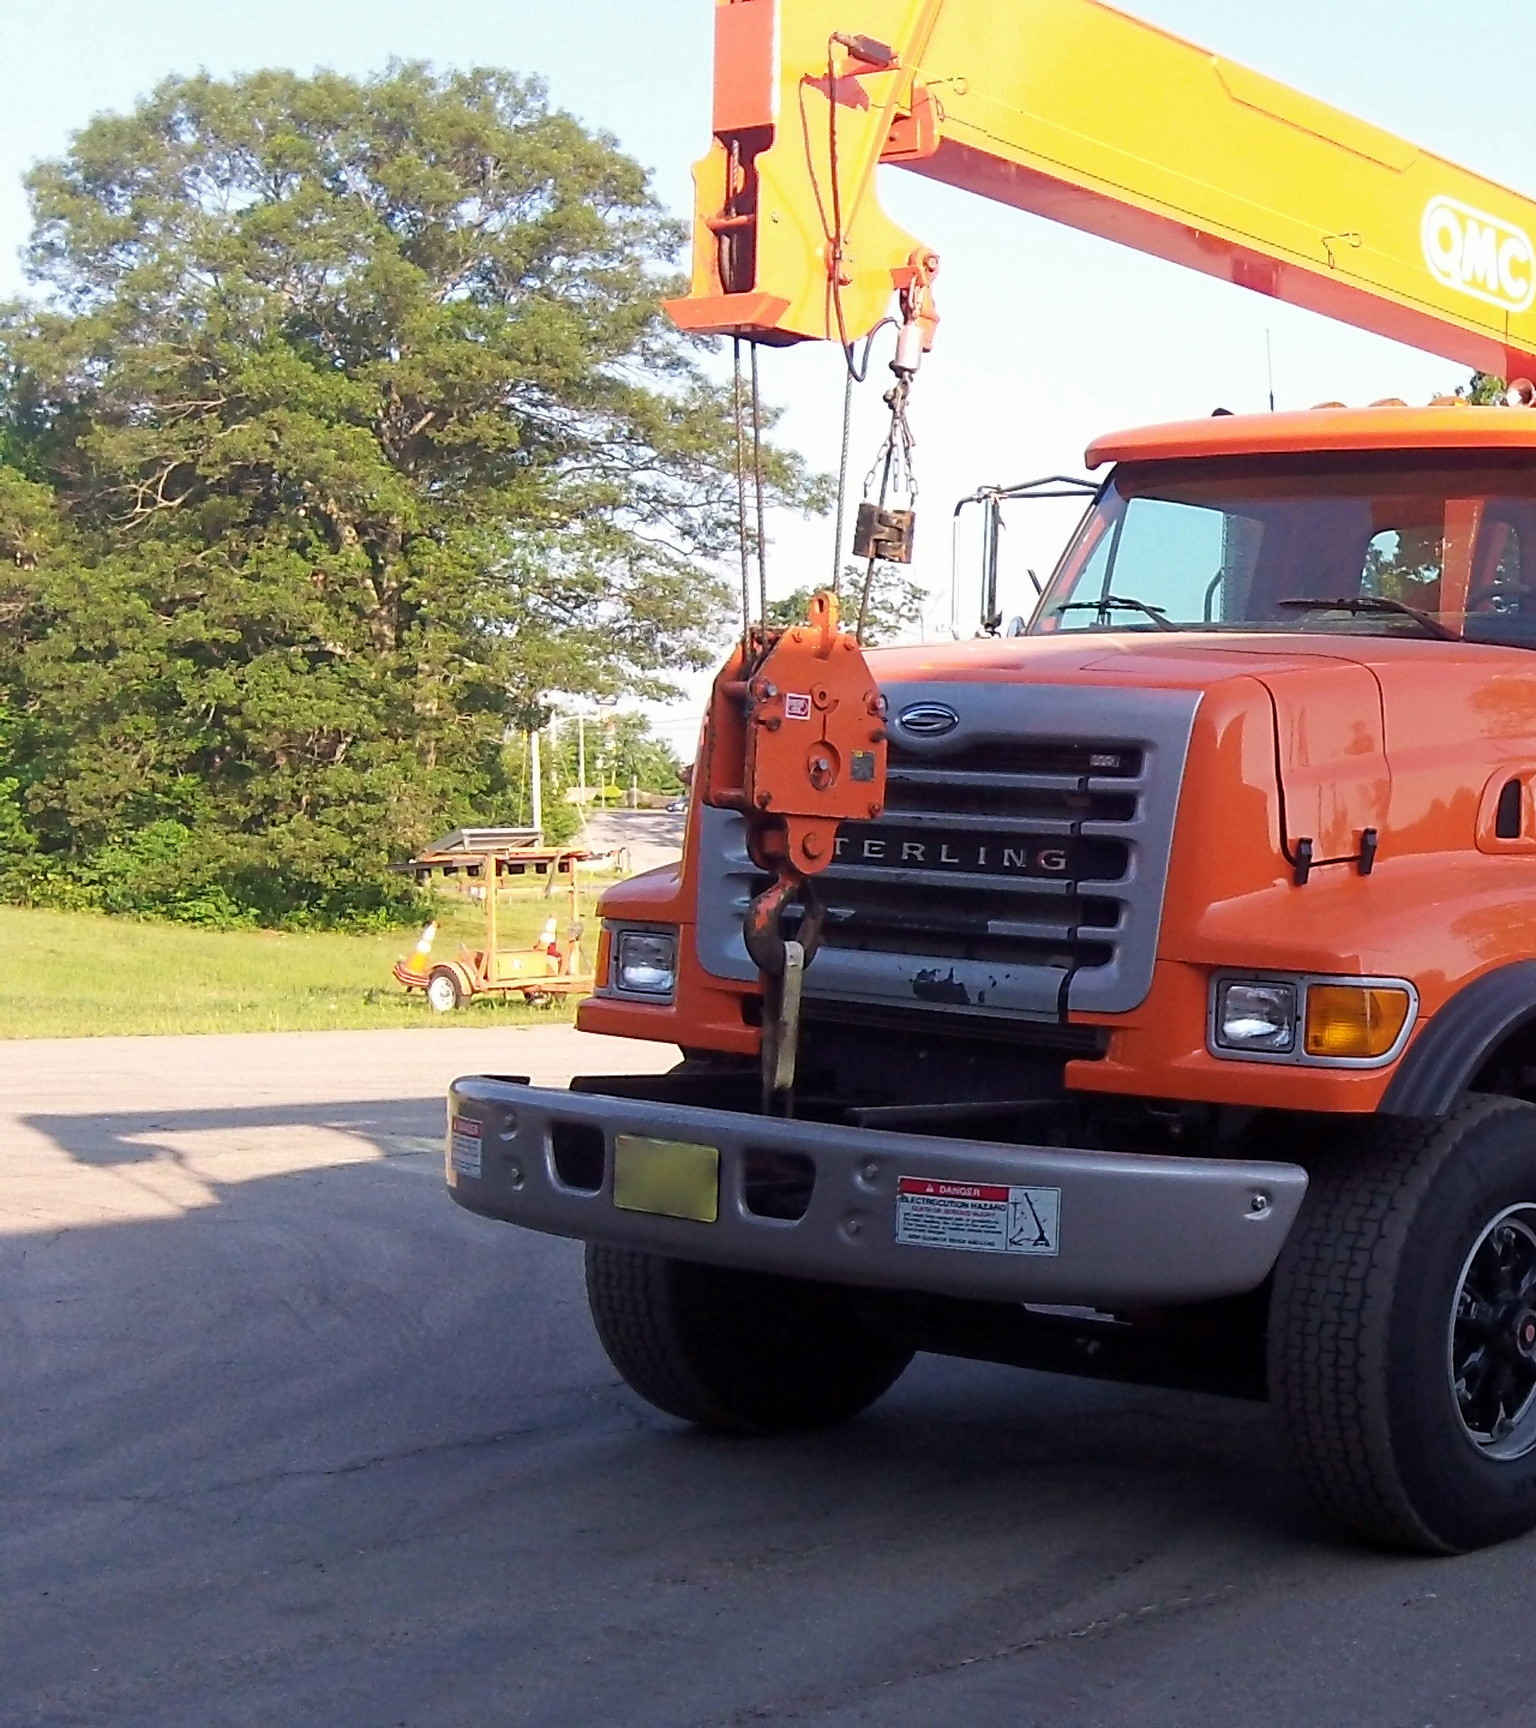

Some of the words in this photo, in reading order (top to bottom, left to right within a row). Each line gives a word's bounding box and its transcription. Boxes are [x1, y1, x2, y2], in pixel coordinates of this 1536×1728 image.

[1425, 206, 1530, 299] QMC
[835, 838, 1067, 871] TERLING
[940, 1184, 980, 1198] DANGER
